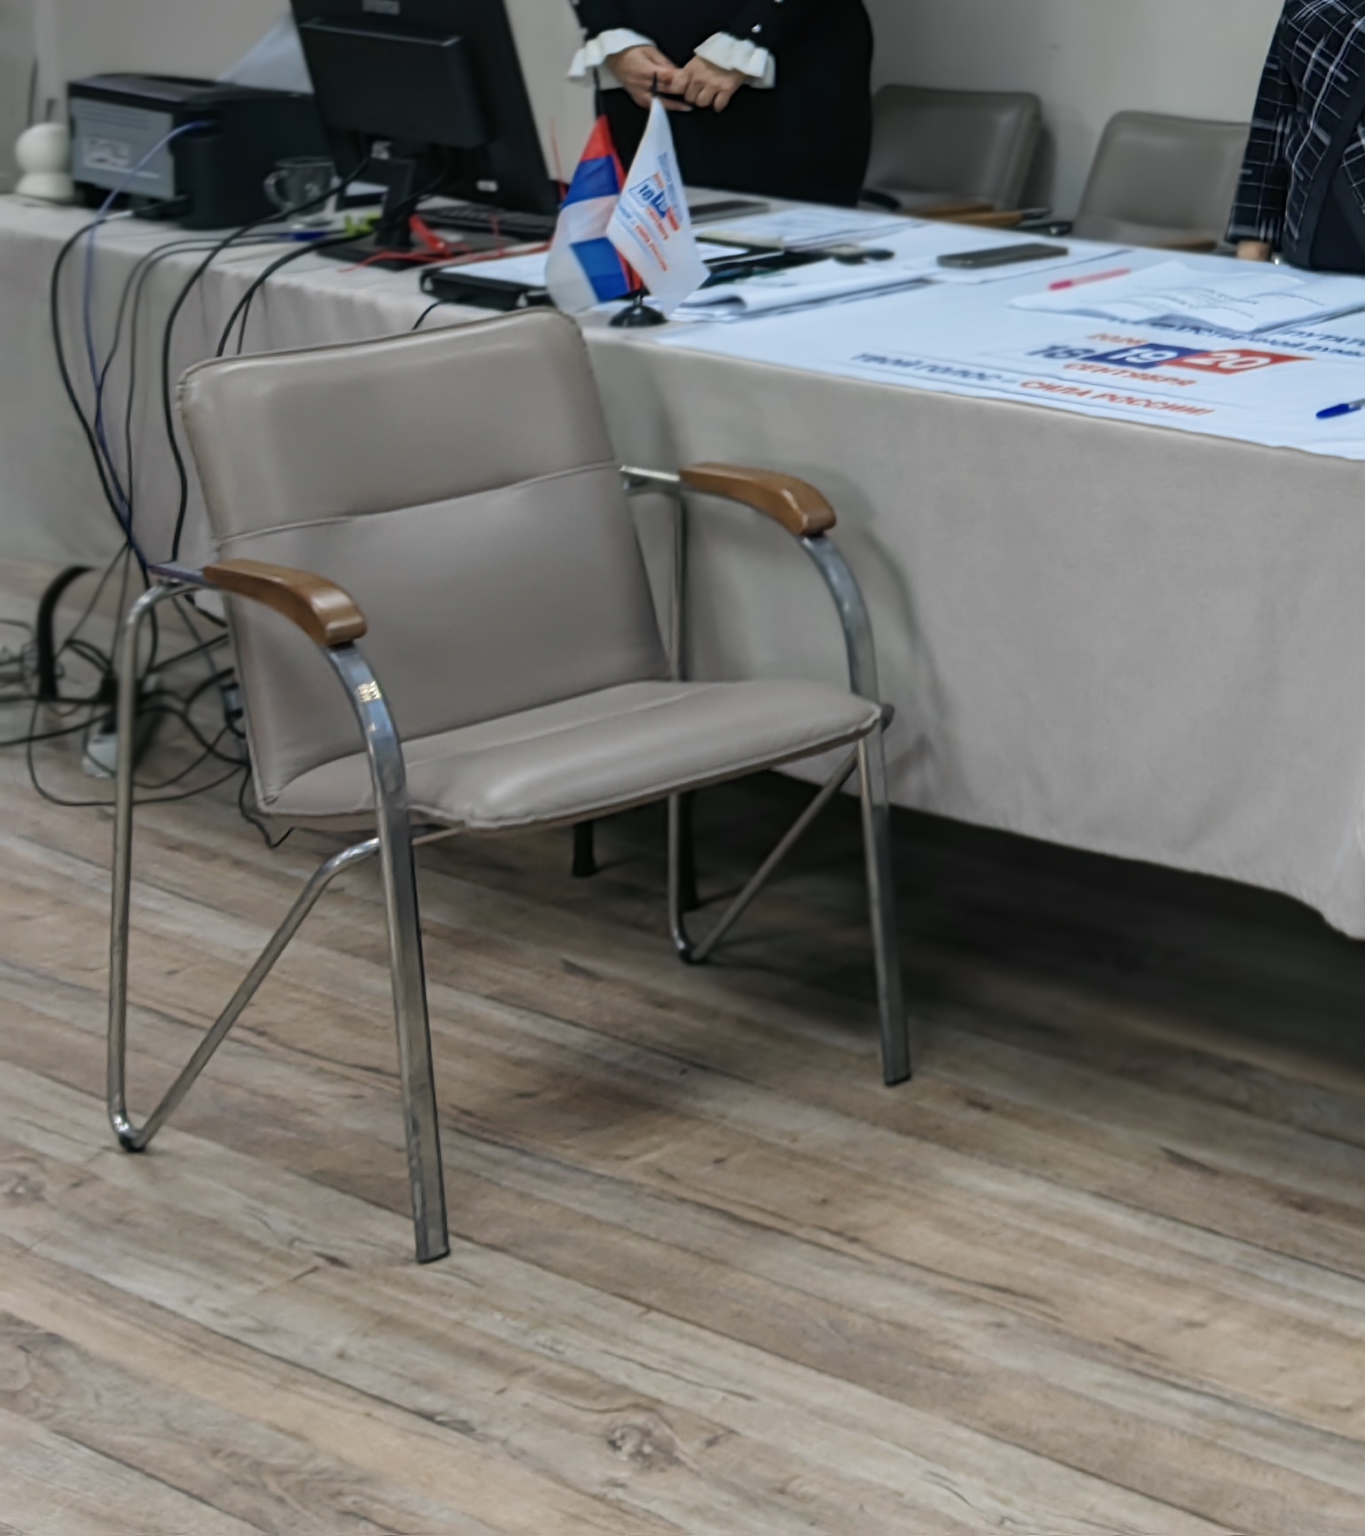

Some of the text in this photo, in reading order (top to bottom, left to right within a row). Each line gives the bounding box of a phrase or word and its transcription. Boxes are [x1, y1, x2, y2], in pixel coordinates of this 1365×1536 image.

[1024, 345, 1096, 361] 18
[1107, 348, 1179, 364] 19
[1183, 351, 1271, 370] 20
[1020, 380, 1093, 397] СИЛА
